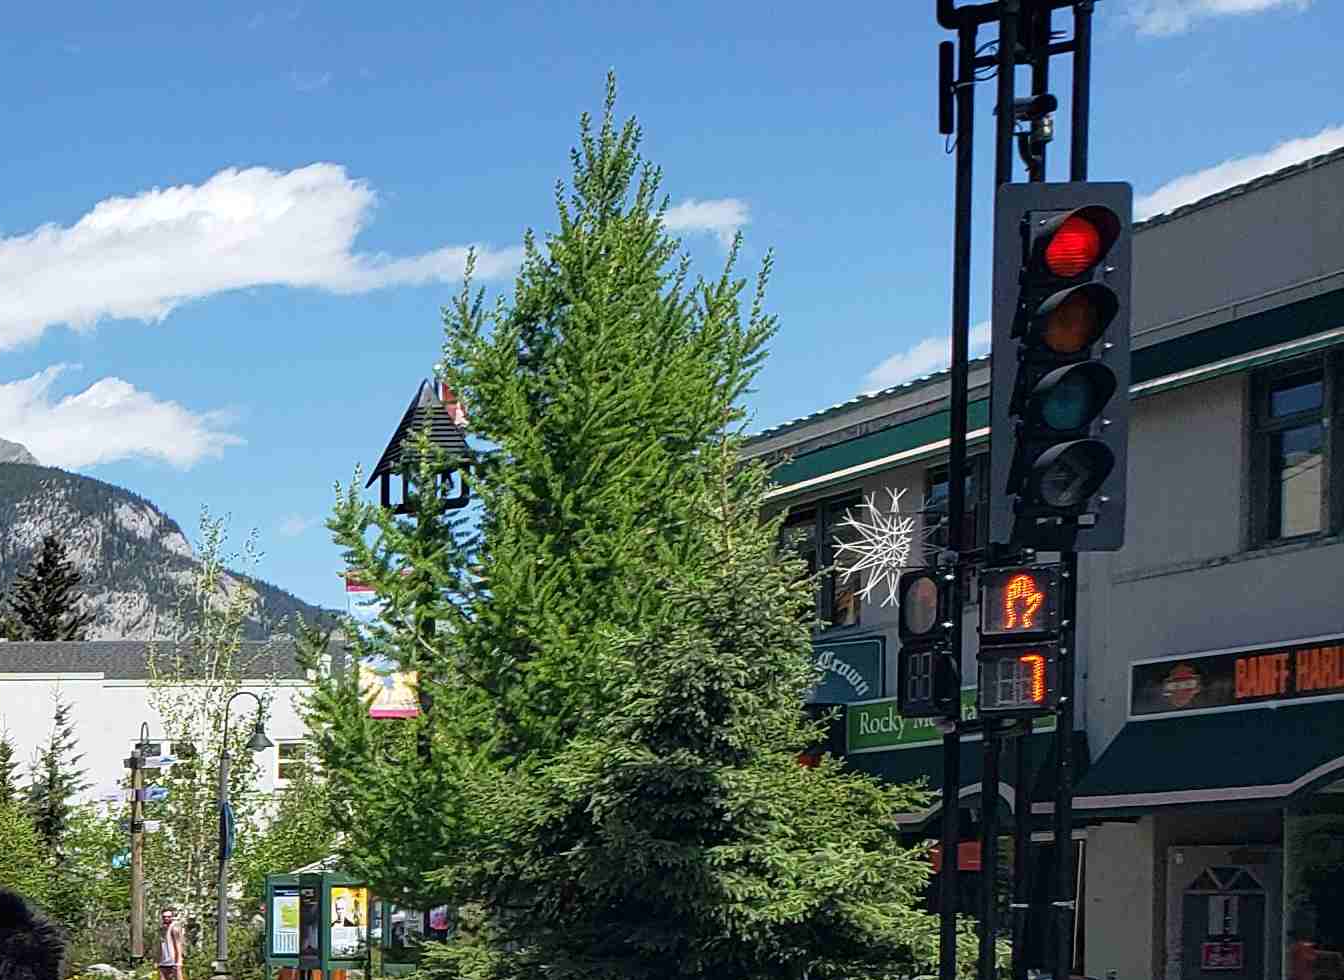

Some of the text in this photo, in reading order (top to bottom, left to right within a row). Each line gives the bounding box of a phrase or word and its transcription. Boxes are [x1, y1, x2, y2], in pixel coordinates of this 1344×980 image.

[815, 650, 869, 697] Crown
[1235, 652, 1289, 699] BANFF
[859, 706, 904, 740] Rocky
